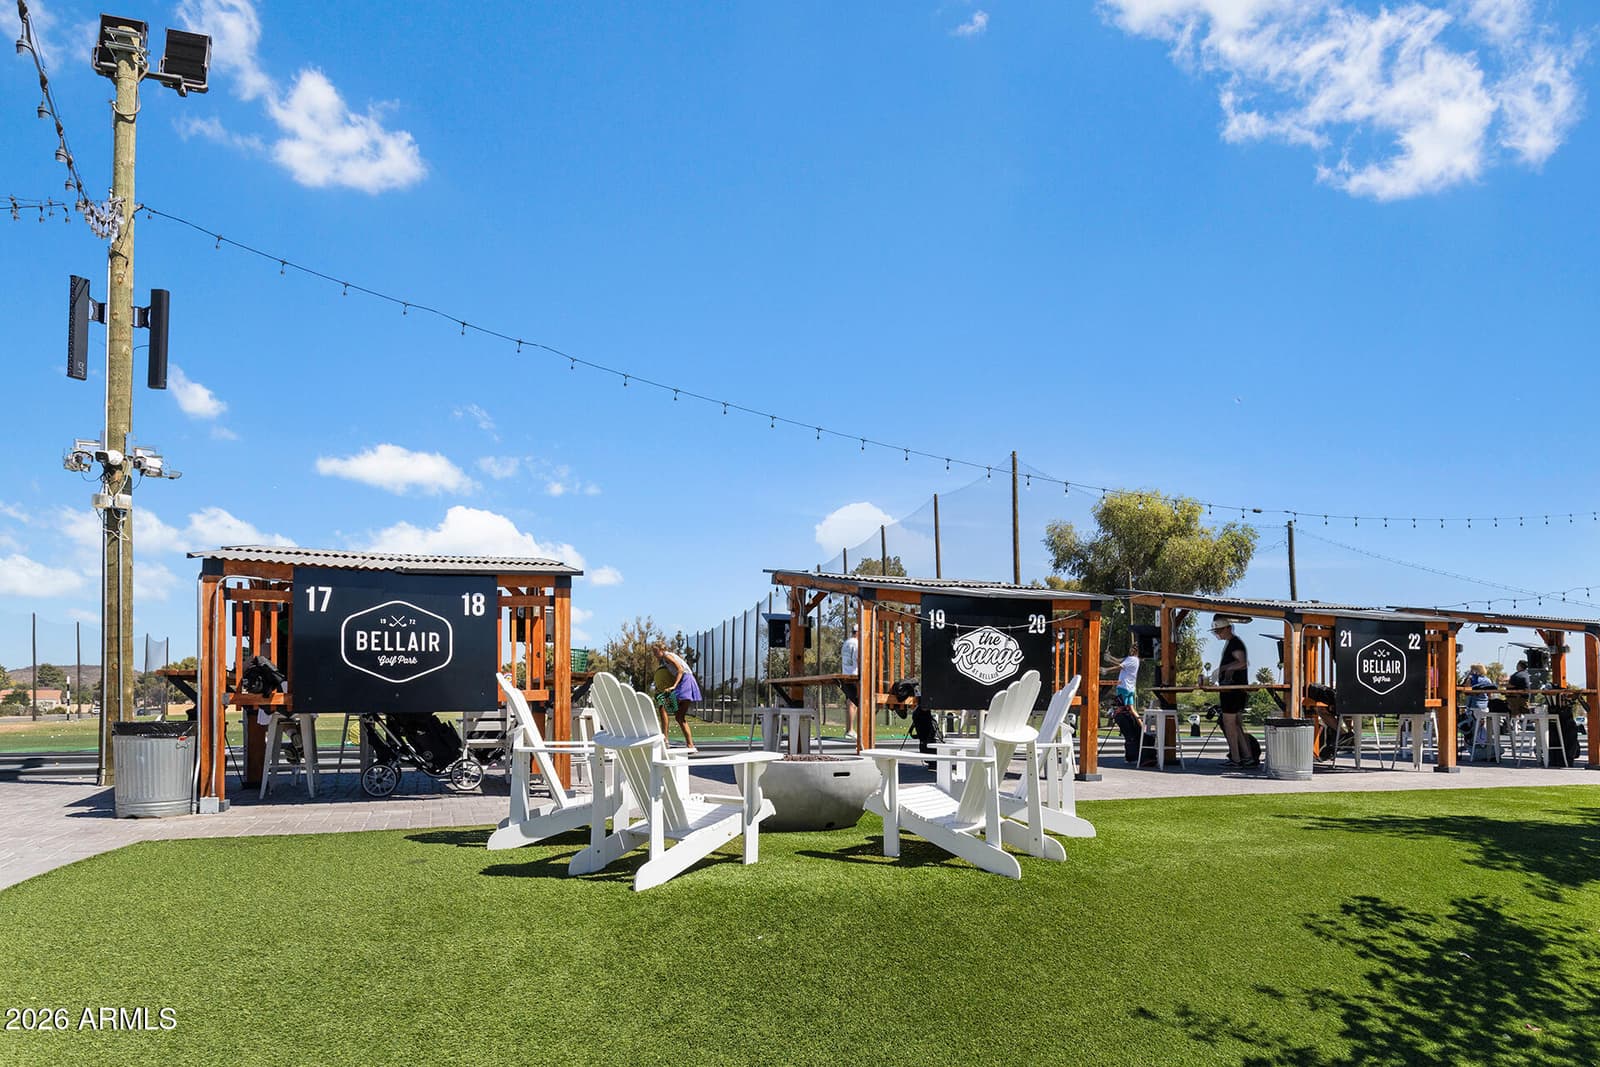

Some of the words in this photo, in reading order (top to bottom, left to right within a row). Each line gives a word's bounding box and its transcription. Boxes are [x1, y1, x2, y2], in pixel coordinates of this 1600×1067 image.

[305, 585, 333, 613] 17
[461, 592, 486, 617] 18
[928, 609, 945, 629] 19
[1028, 614, 1046, 634] 20
[356, 630, 440, 652] BELLAIR
[978, 631, 1002, 646] the
[1340, 630, 1352, 647] 21
[1408, 633, 1421, 650] 22
[377, 654, 397, 667] Golf
[397, 655, 418, 665] Park
[951, 640, 1025, 673] Range
[1362, 659, 1401, 674] BELLAIR
